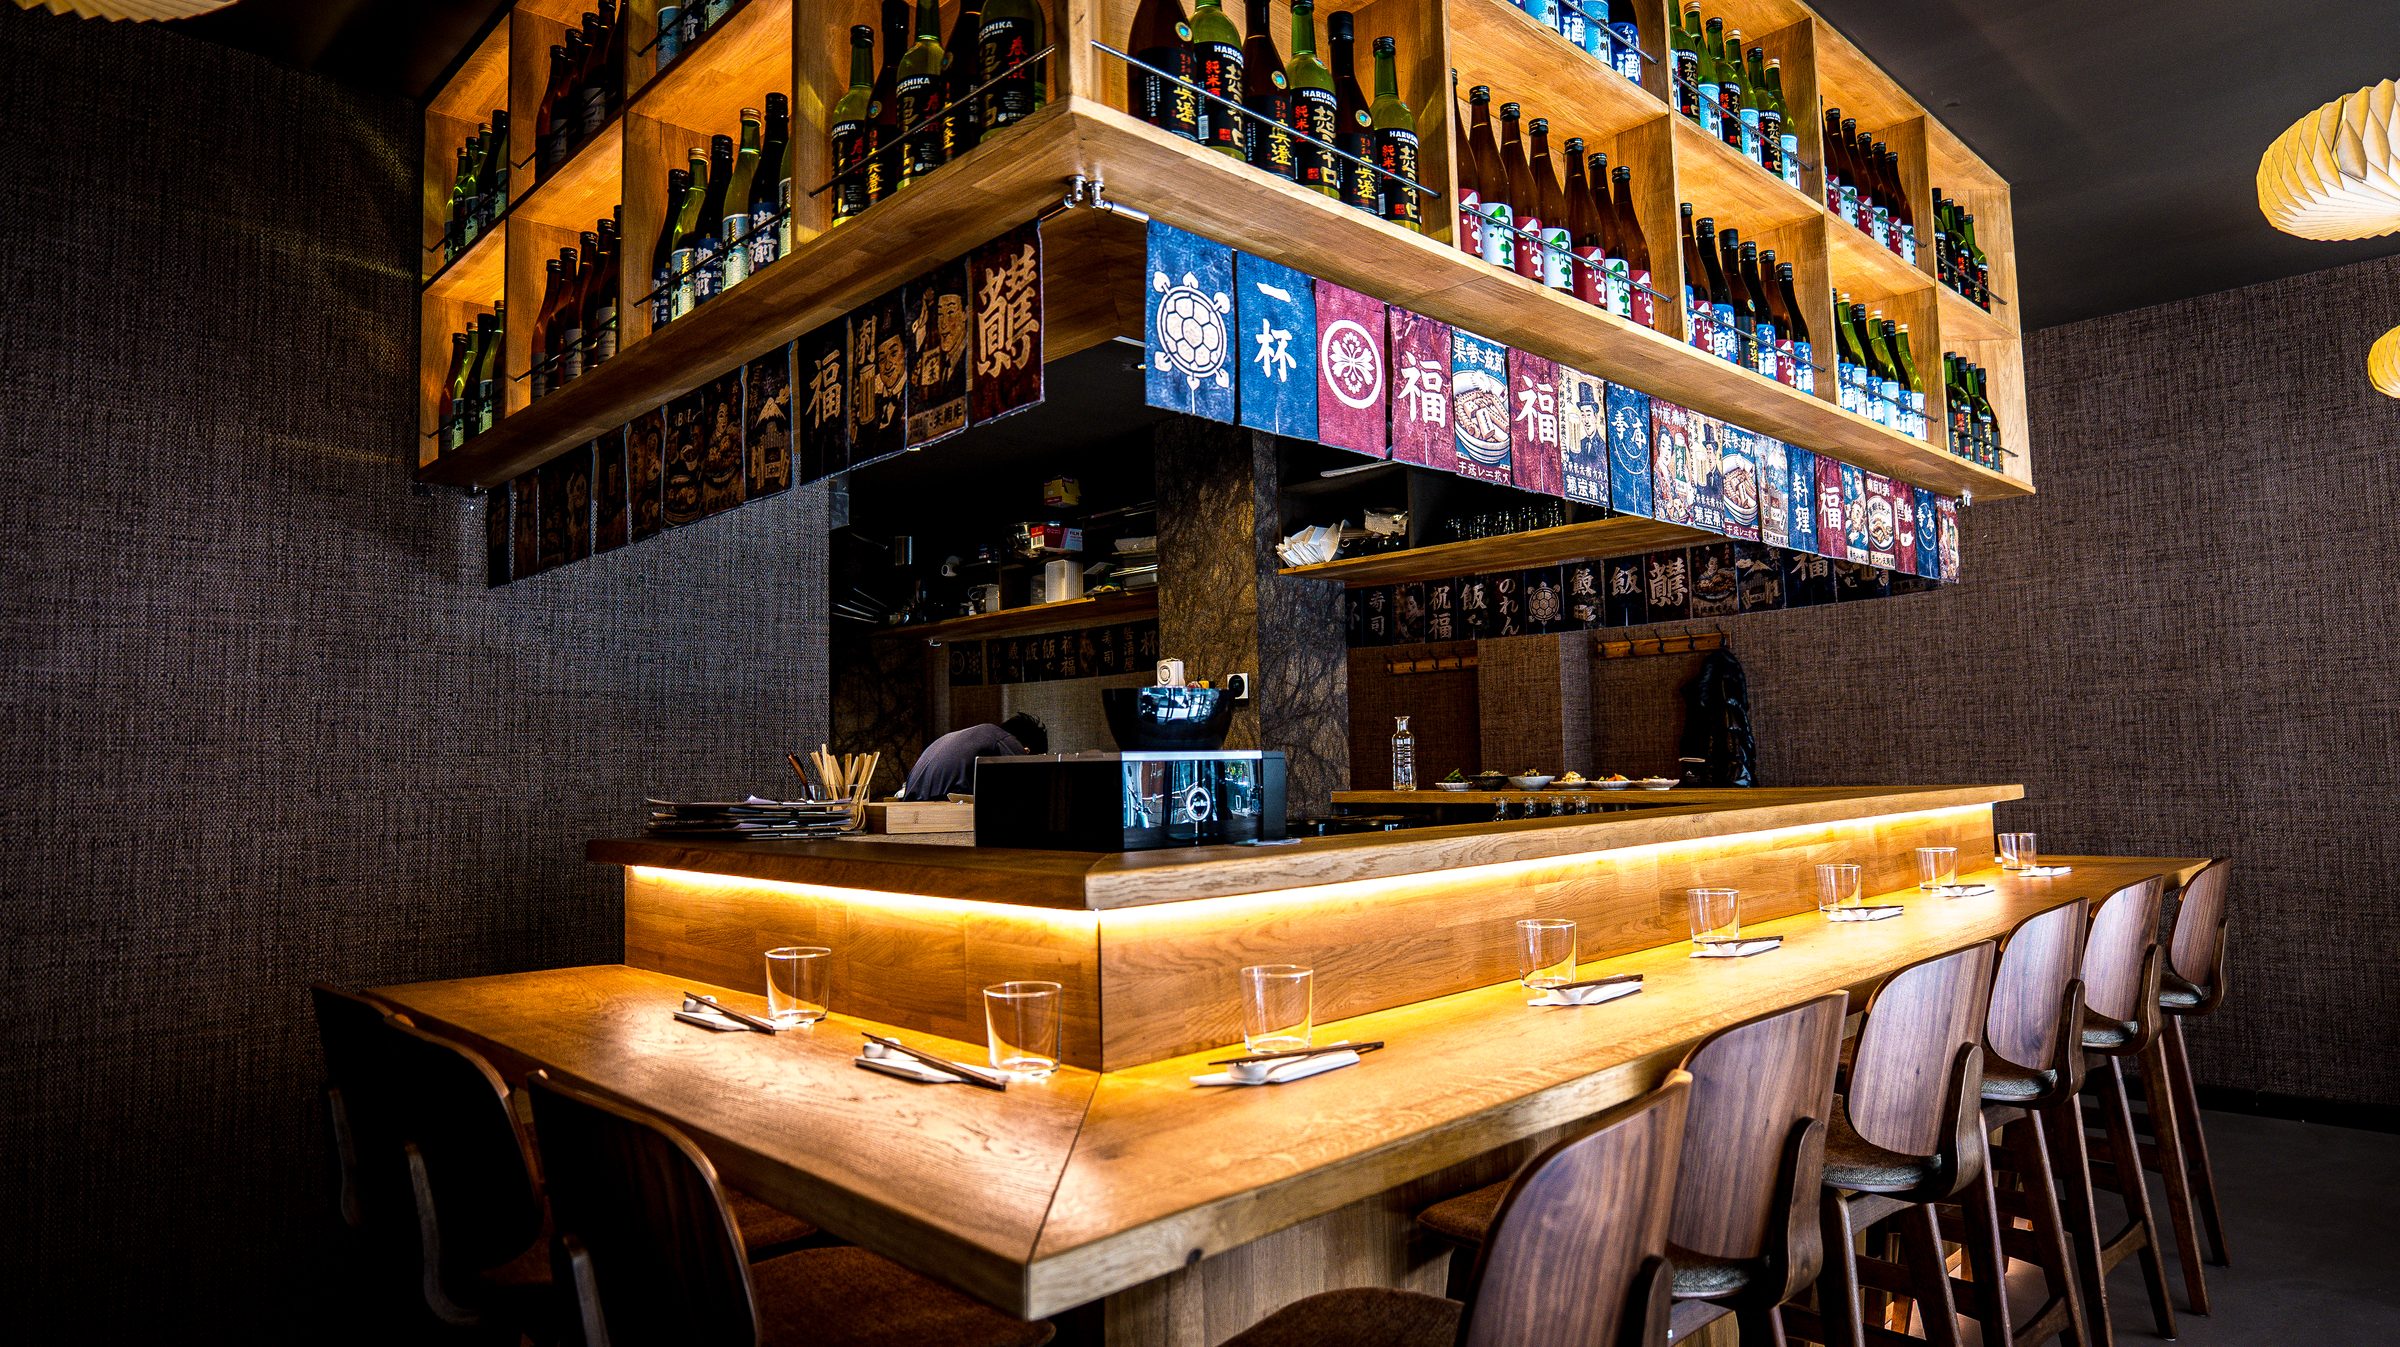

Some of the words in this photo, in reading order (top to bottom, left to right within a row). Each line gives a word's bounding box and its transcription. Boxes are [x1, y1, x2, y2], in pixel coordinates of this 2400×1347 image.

[1254, 281, 1297, 383] 一杯
[805, 349, 842, 430] 福
[1397, 352, 1447, 429] 福
[1514, 376, 1559, 449] 福
[1792, 471, 1812, 534] 料理
[1819, 482, 1842, 532] 福
[1460, 583, 1489, 611] 飯
[1498, 578, 1521, 636] のれん
[1609, 566, 1643, 597] 飯
[1368, 589, 1386, 637] 寿司
[1428, 585, 1454, 640] 祝福
